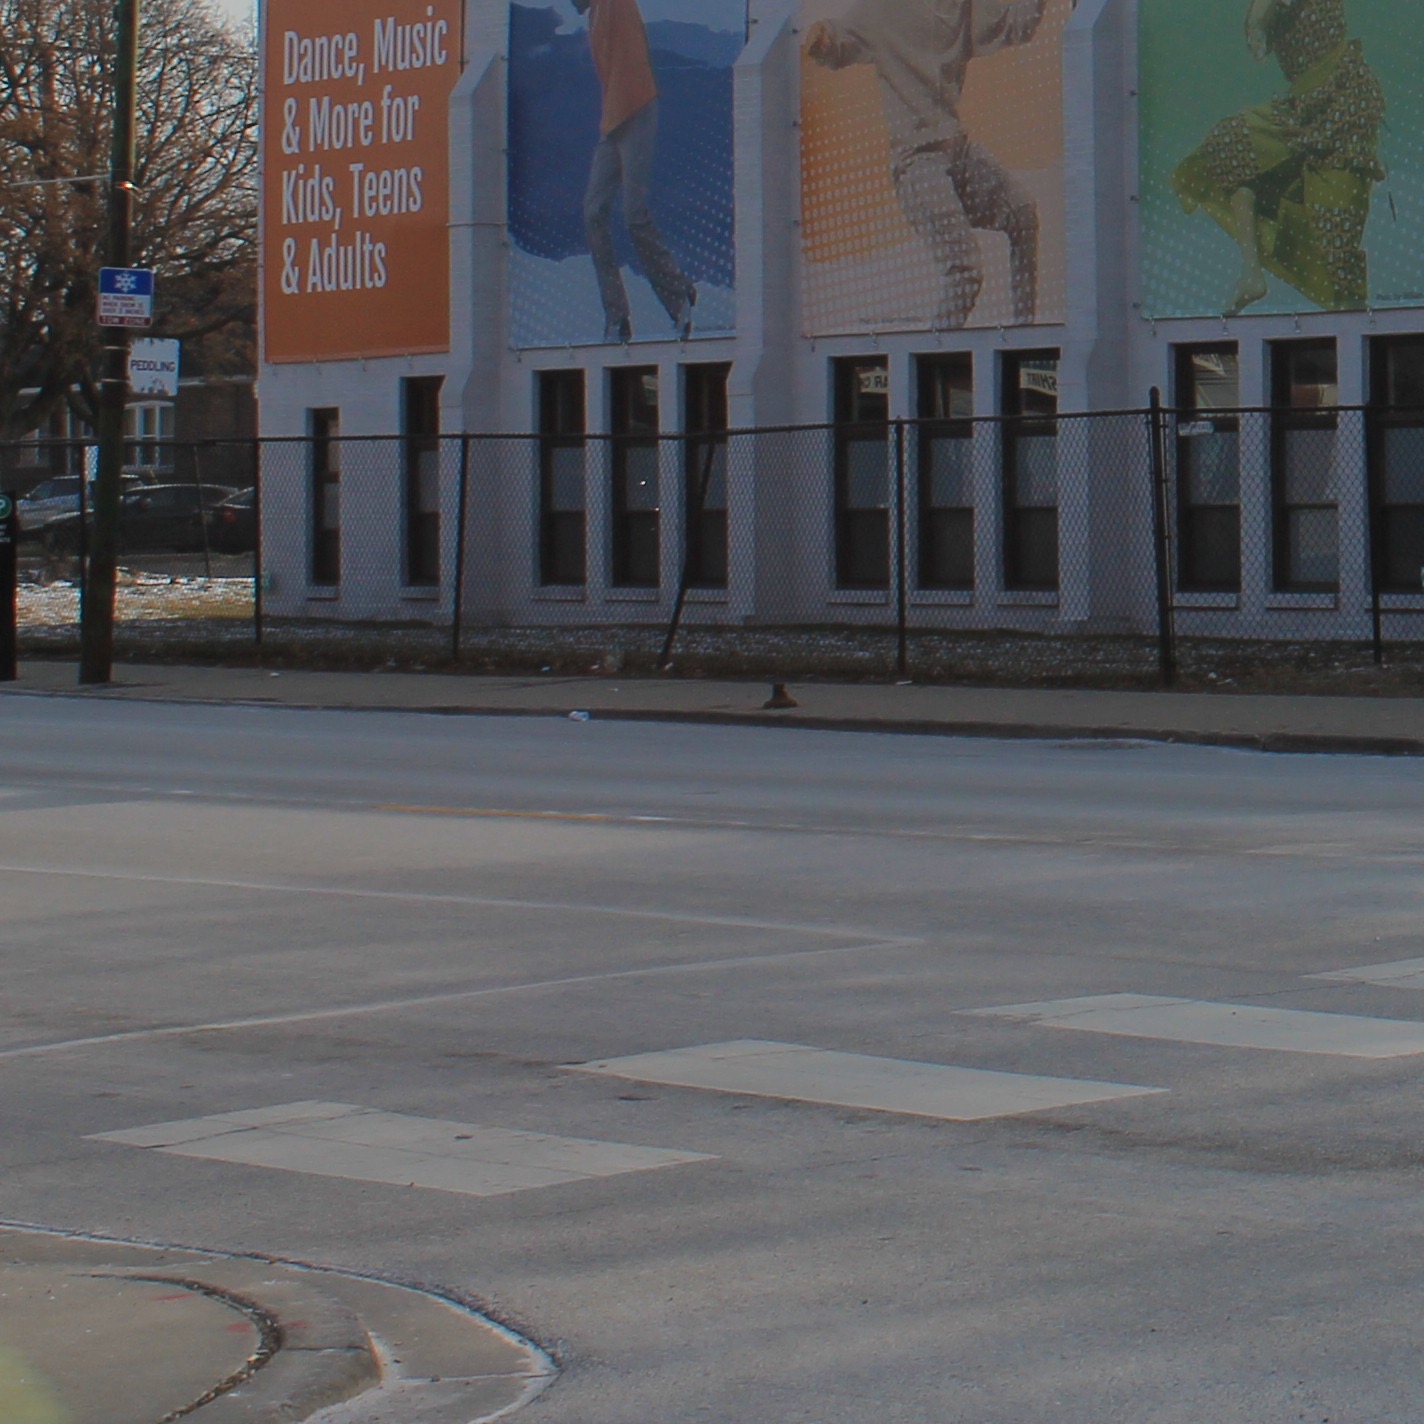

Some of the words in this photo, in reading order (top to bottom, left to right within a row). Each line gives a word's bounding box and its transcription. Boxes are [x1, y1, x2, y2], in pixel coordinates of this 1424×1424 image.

[283, 30, 365, 86] Dance,
[373, 5, 448, 74] Music
[281, 96, 300, 155] &
[309, 95, 373, 152] More
[381, 84, 419, 144] for
[281, 163, 342, 230] Kids,
[349, 162, 424, 218] Teens
[281, 236, 300, 295] &
[307, 230, 388, 293] Adults
[130, 359, 176, 373] PEDDLING
